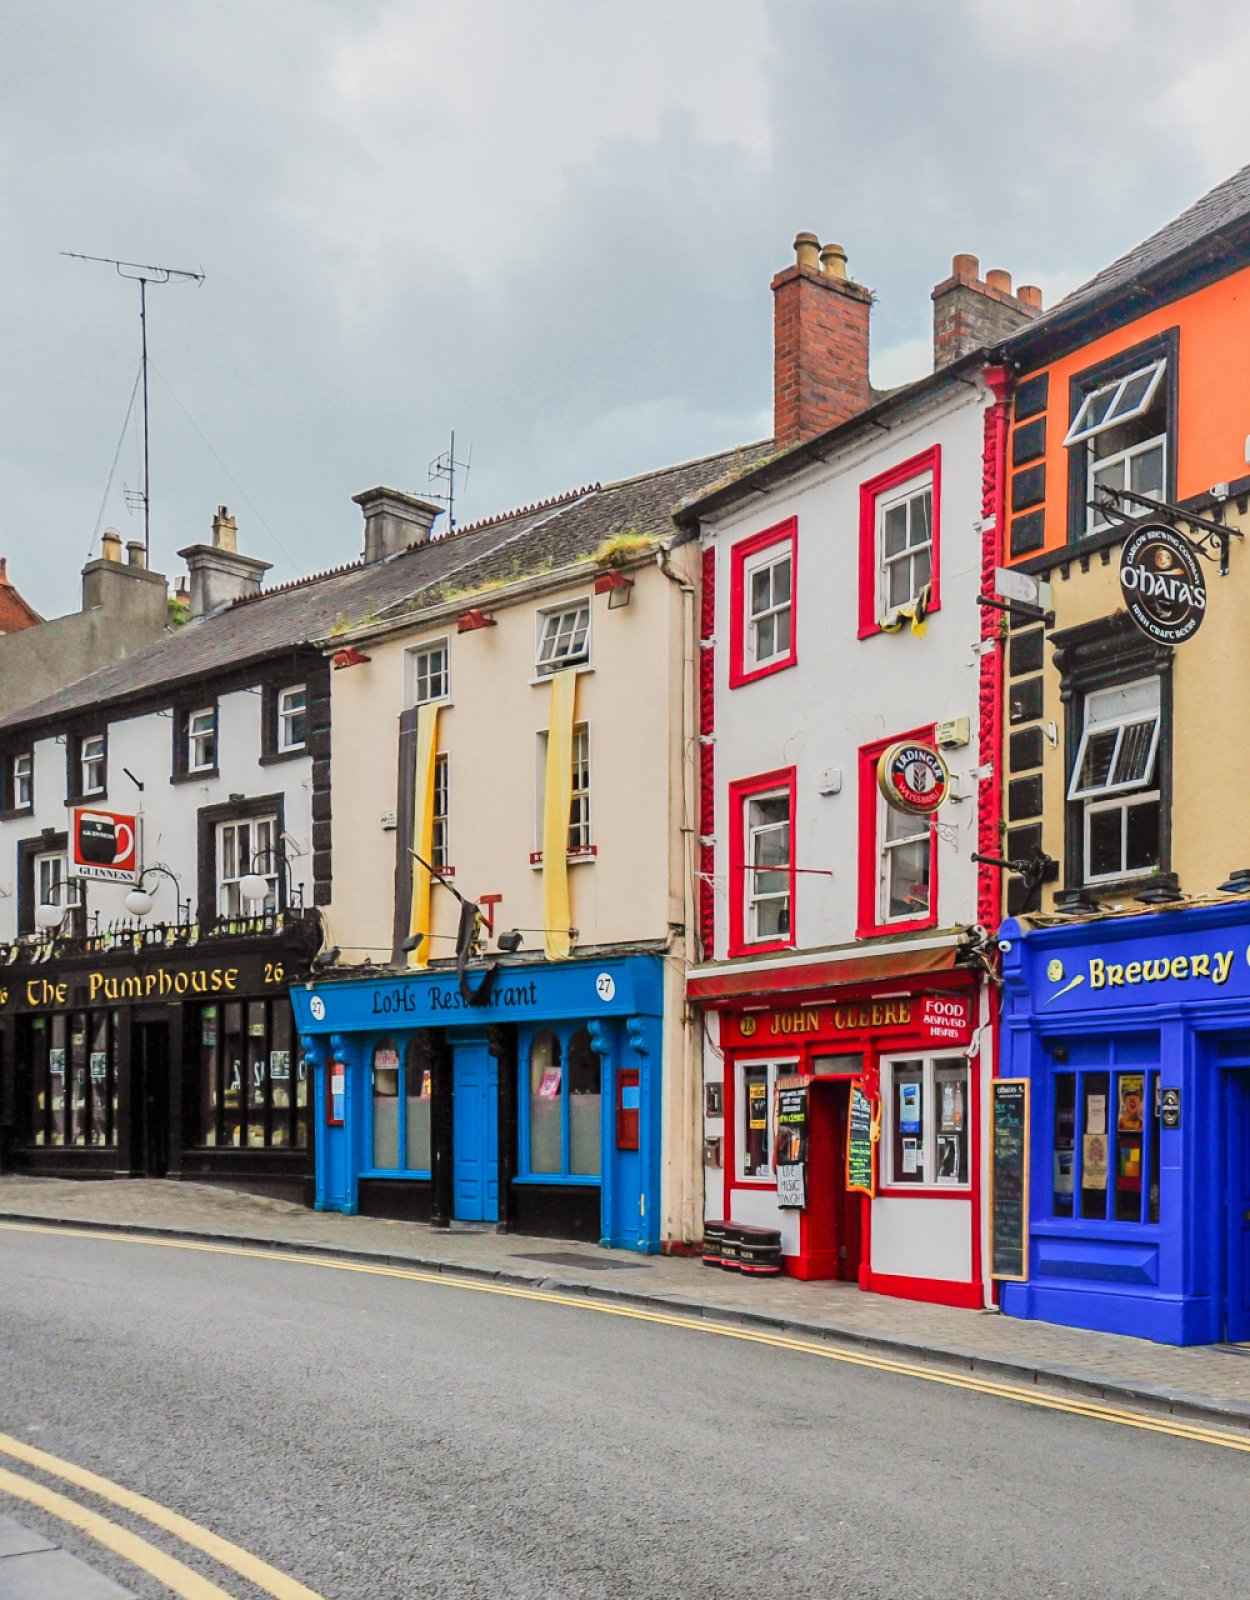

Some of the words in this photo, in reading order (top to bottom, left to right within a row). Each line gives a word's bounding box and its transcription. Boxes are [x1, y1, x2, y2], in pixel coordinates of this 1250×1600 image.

[896, 750, 942, 777] ERDINGER
[82, 829, 115, 839] GUINNESS
[79, 866, 134, 880] GUINNESS
[0, 987, 9, 1004] 6
[264, 962, 285, 984] 26
[312, 1001, 322, 1014] 27
[428, 981, 538, 1010] Resrant
[598, 978, 611, 994] 27
[925, 1001, 964, 1017] FOOD
[743, 1018, 754, 1032] 28
[770, 1011, 820, 1035] JOHN
[834, 1003, 912, 1030] CLEERE
[923, 1014, 966, 1028] SERVED
[930, 1026, 959, 1038] HERE
